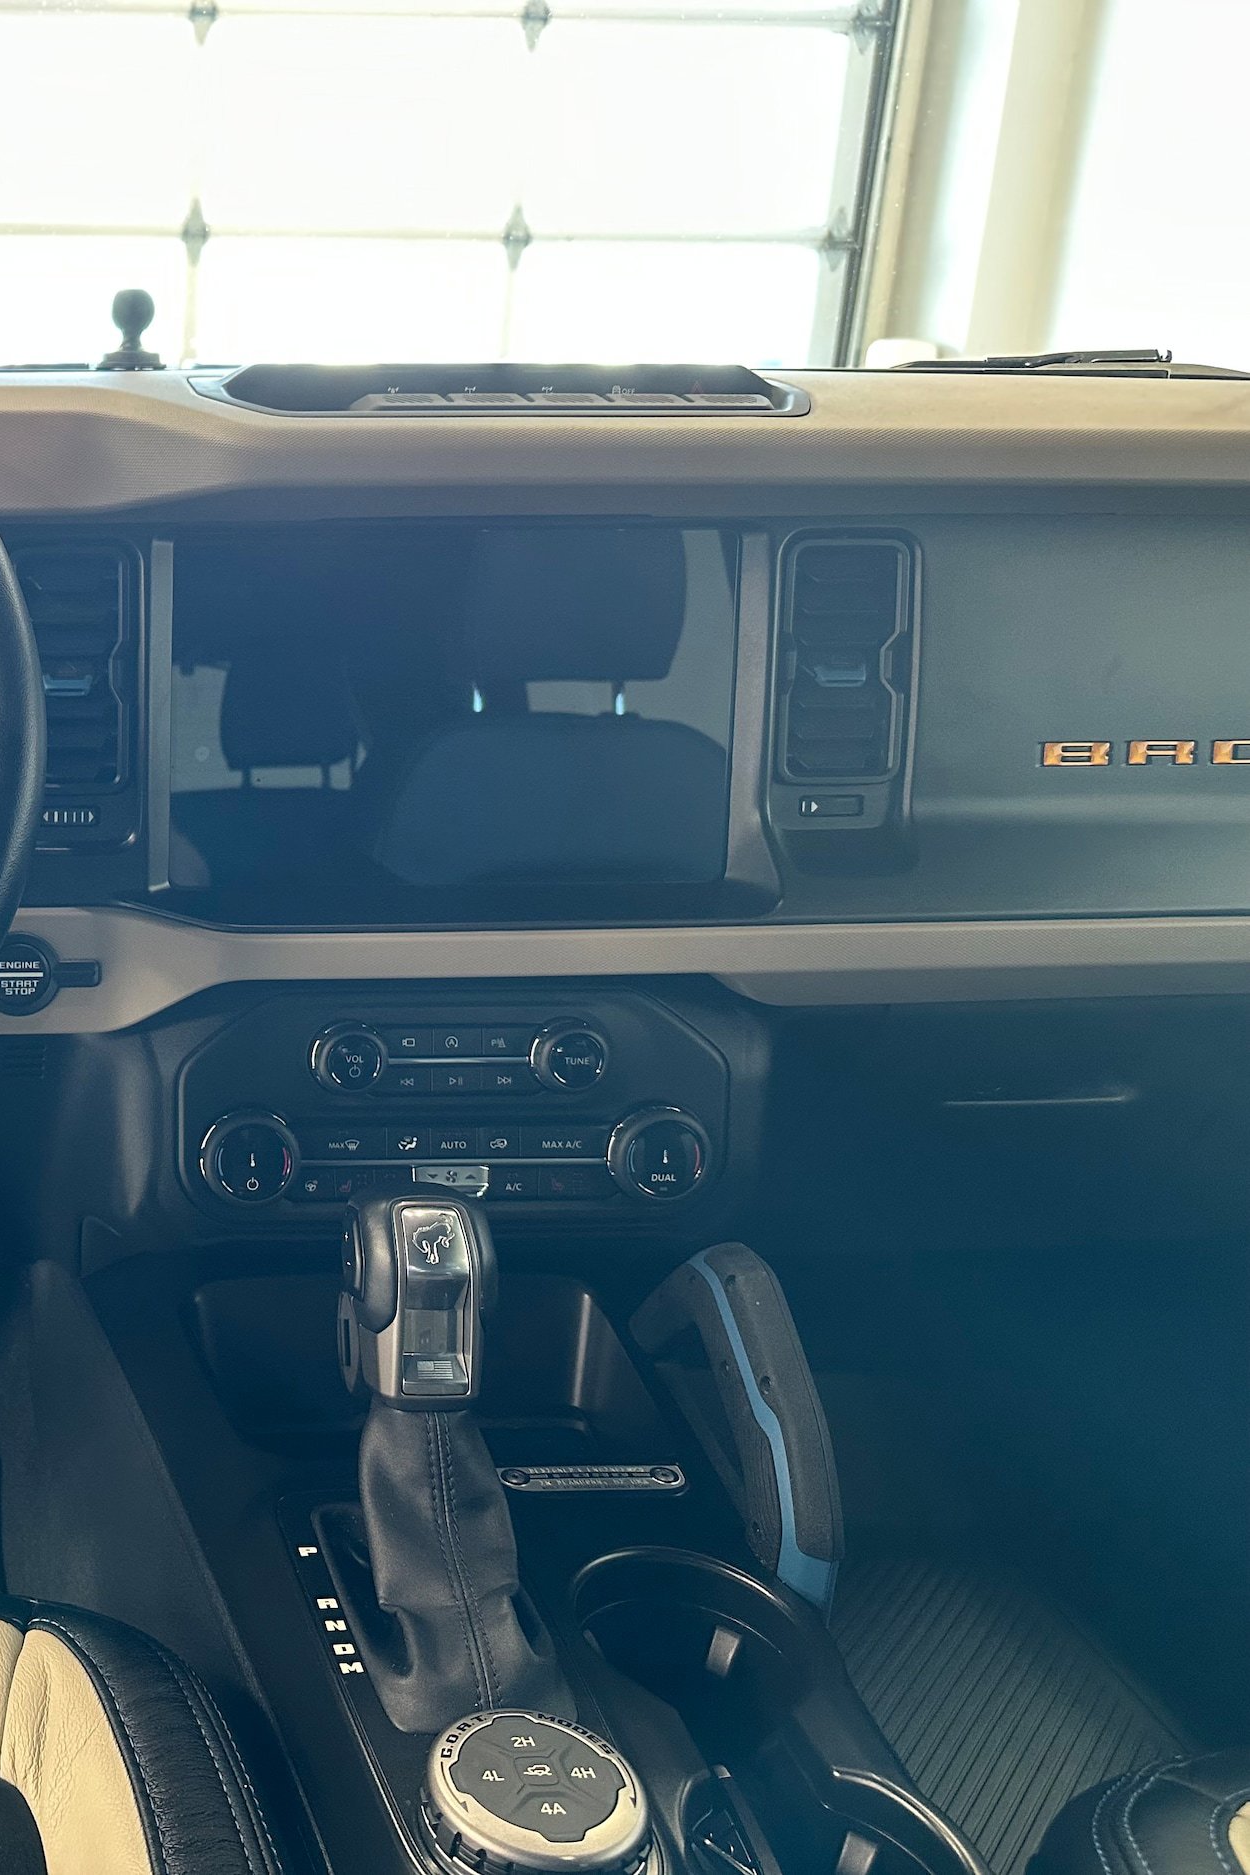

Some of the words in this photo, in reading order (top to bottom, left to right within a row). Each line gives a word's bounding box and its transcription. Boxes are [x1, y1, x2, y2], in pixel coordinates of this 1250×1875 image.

[0, 980, 40, 988] START
[5, 987, 36, 996] STOP
[345, 1055, 364, 1064] VOL
[564, 1056, 590, 1066] TUNE
[328, 1142, 345, 1150] MAX
[440, 1141, 467, 1150] AUTO
[542, 1140, 563, 1149] MAX
[565, 1140, 582, 1149] A/C
[651, 1173, 677, 1182] DUAL
[505, 1182, 523, 1192] A/C
[298, 1546, 318, 1557] P
[324, 1620, 347, 1631] N
[339, 1661, 364, 1674] M
[537, 1713, 615, 1754] MODES
[511, 1735, 536, 1748] 2H
[482, 1769, 505, 1782] 4L
[570, 1766, 597, 1779] 4H
[540, 1802, 567, 1815] 4A
